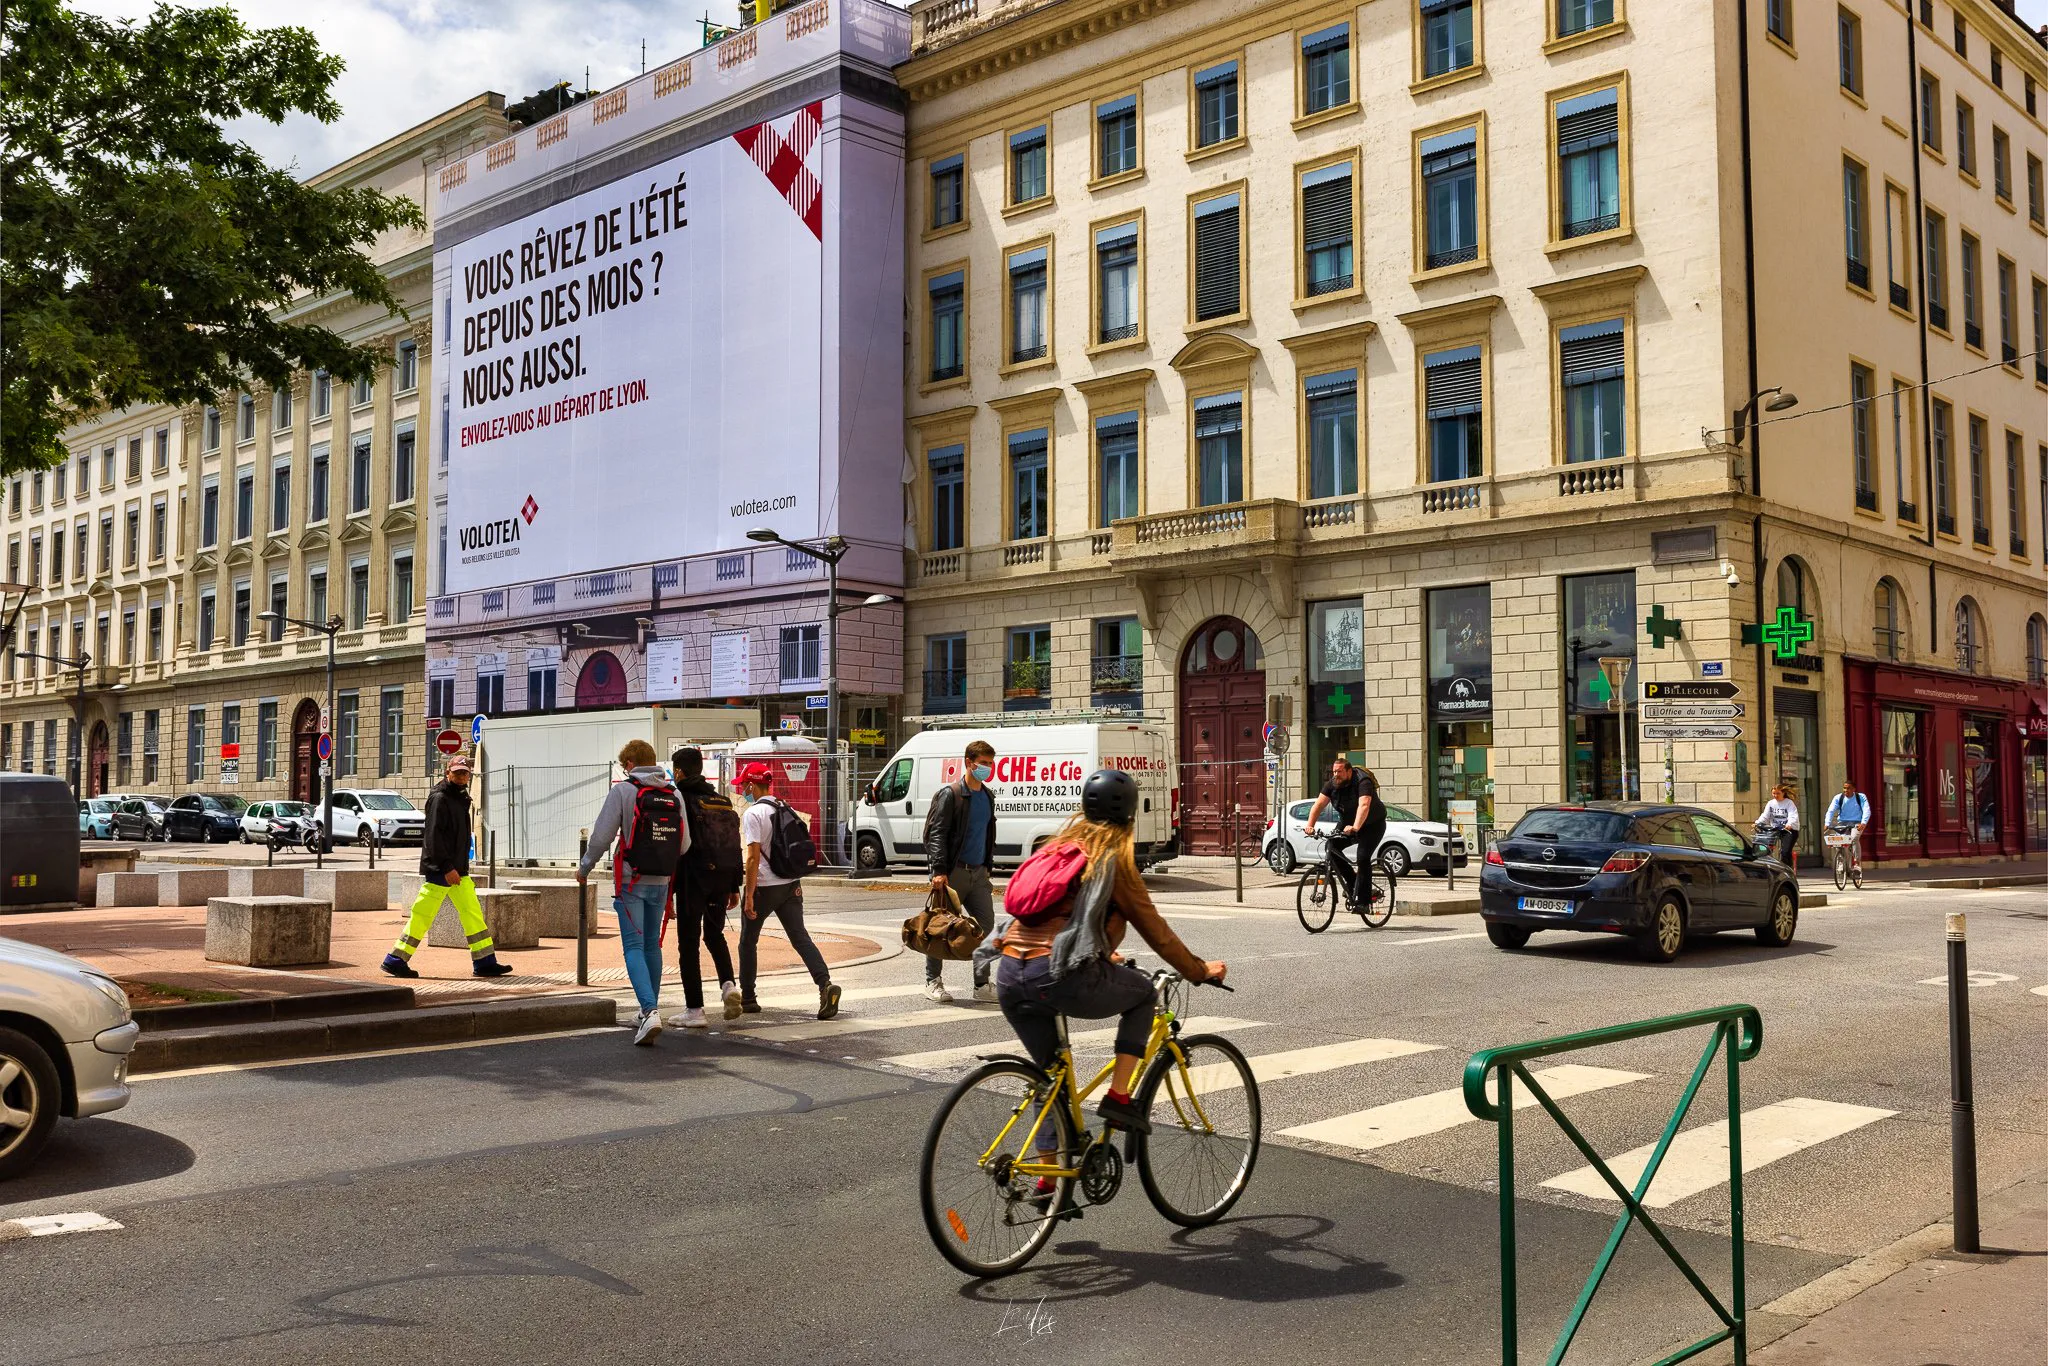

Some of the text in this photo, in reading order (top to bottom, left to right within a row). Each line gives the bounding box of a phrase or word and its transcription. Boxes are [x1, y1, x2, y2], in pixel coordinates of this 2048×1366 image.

[464, 171, 688, 304] VOUS RÊVEZ DE L'ÉTÉ
[463, 251, 664, 357] DEPUIS DES MOIS ?
[463, 335, 587, 409] NOUS AUSSI.
[461, 378, 649, 448] ENVOLEZ-VOUS AU DÉPART DE LYON.
[730, 495, 797, 517] volotea.com
[460, 517, 520, 551] VOLOTEA
[1664, 686, 1719, 695] BELLECOUR
[1438, 699, 1489, 709] Pharmacie Bellecour
[1659, 707, 1682, 716] Office
[1700, 707, 1732, 715] Tourisme
[1041, 763, 1056, 781] et
[1059, 760, 1082, 781] Cie
[1116, 756, 1148, 770] ROCHE
[1012, 786, 1024, 796] 04
[1026, 786, 1038, 796] 78
[1040, 786, 1053, 796] 78
[1054, 785, 1067, 796] 82
[1069, 785, 1082, 796] 10
[1033, 803, 1044, 812] DE
[1045, 802, 1081, 814] FAÇADES
